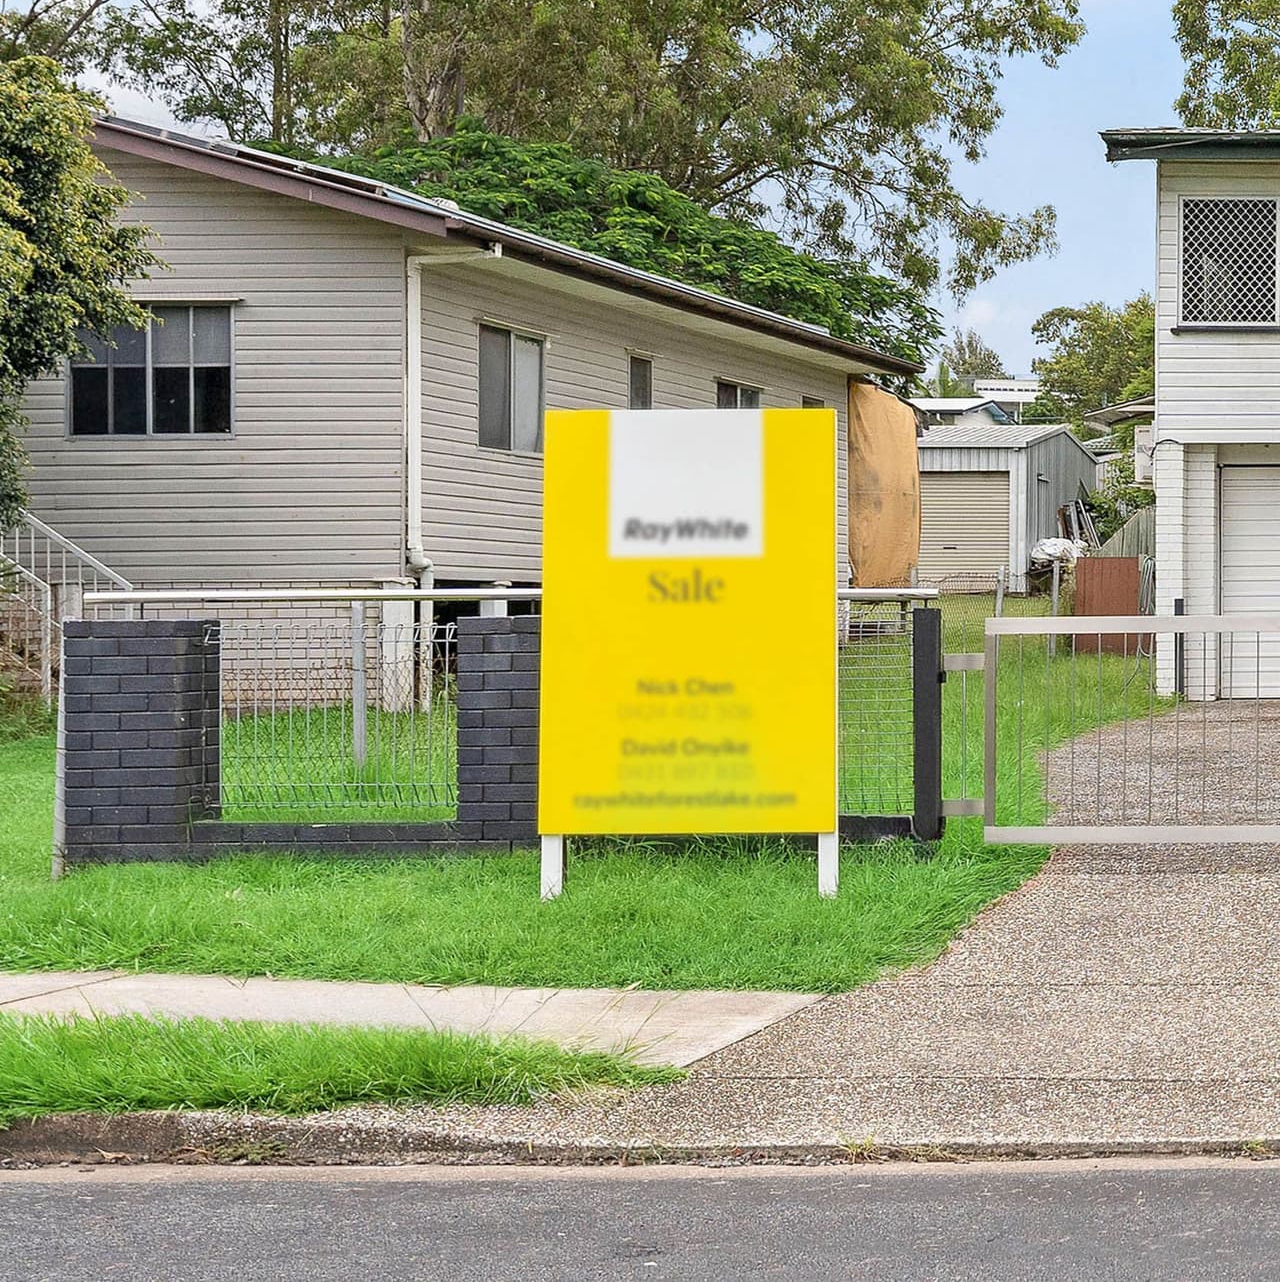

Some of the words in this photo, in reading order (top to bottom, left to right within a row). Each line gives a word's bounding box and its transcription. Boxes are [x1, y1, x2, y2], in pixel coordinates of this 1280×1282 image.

[647, 567, 724, 603] Sale
[636, 678, 679, 696] Nick
[685, 678, 735, 696] Chen
[620, 737, 677, 757] David
